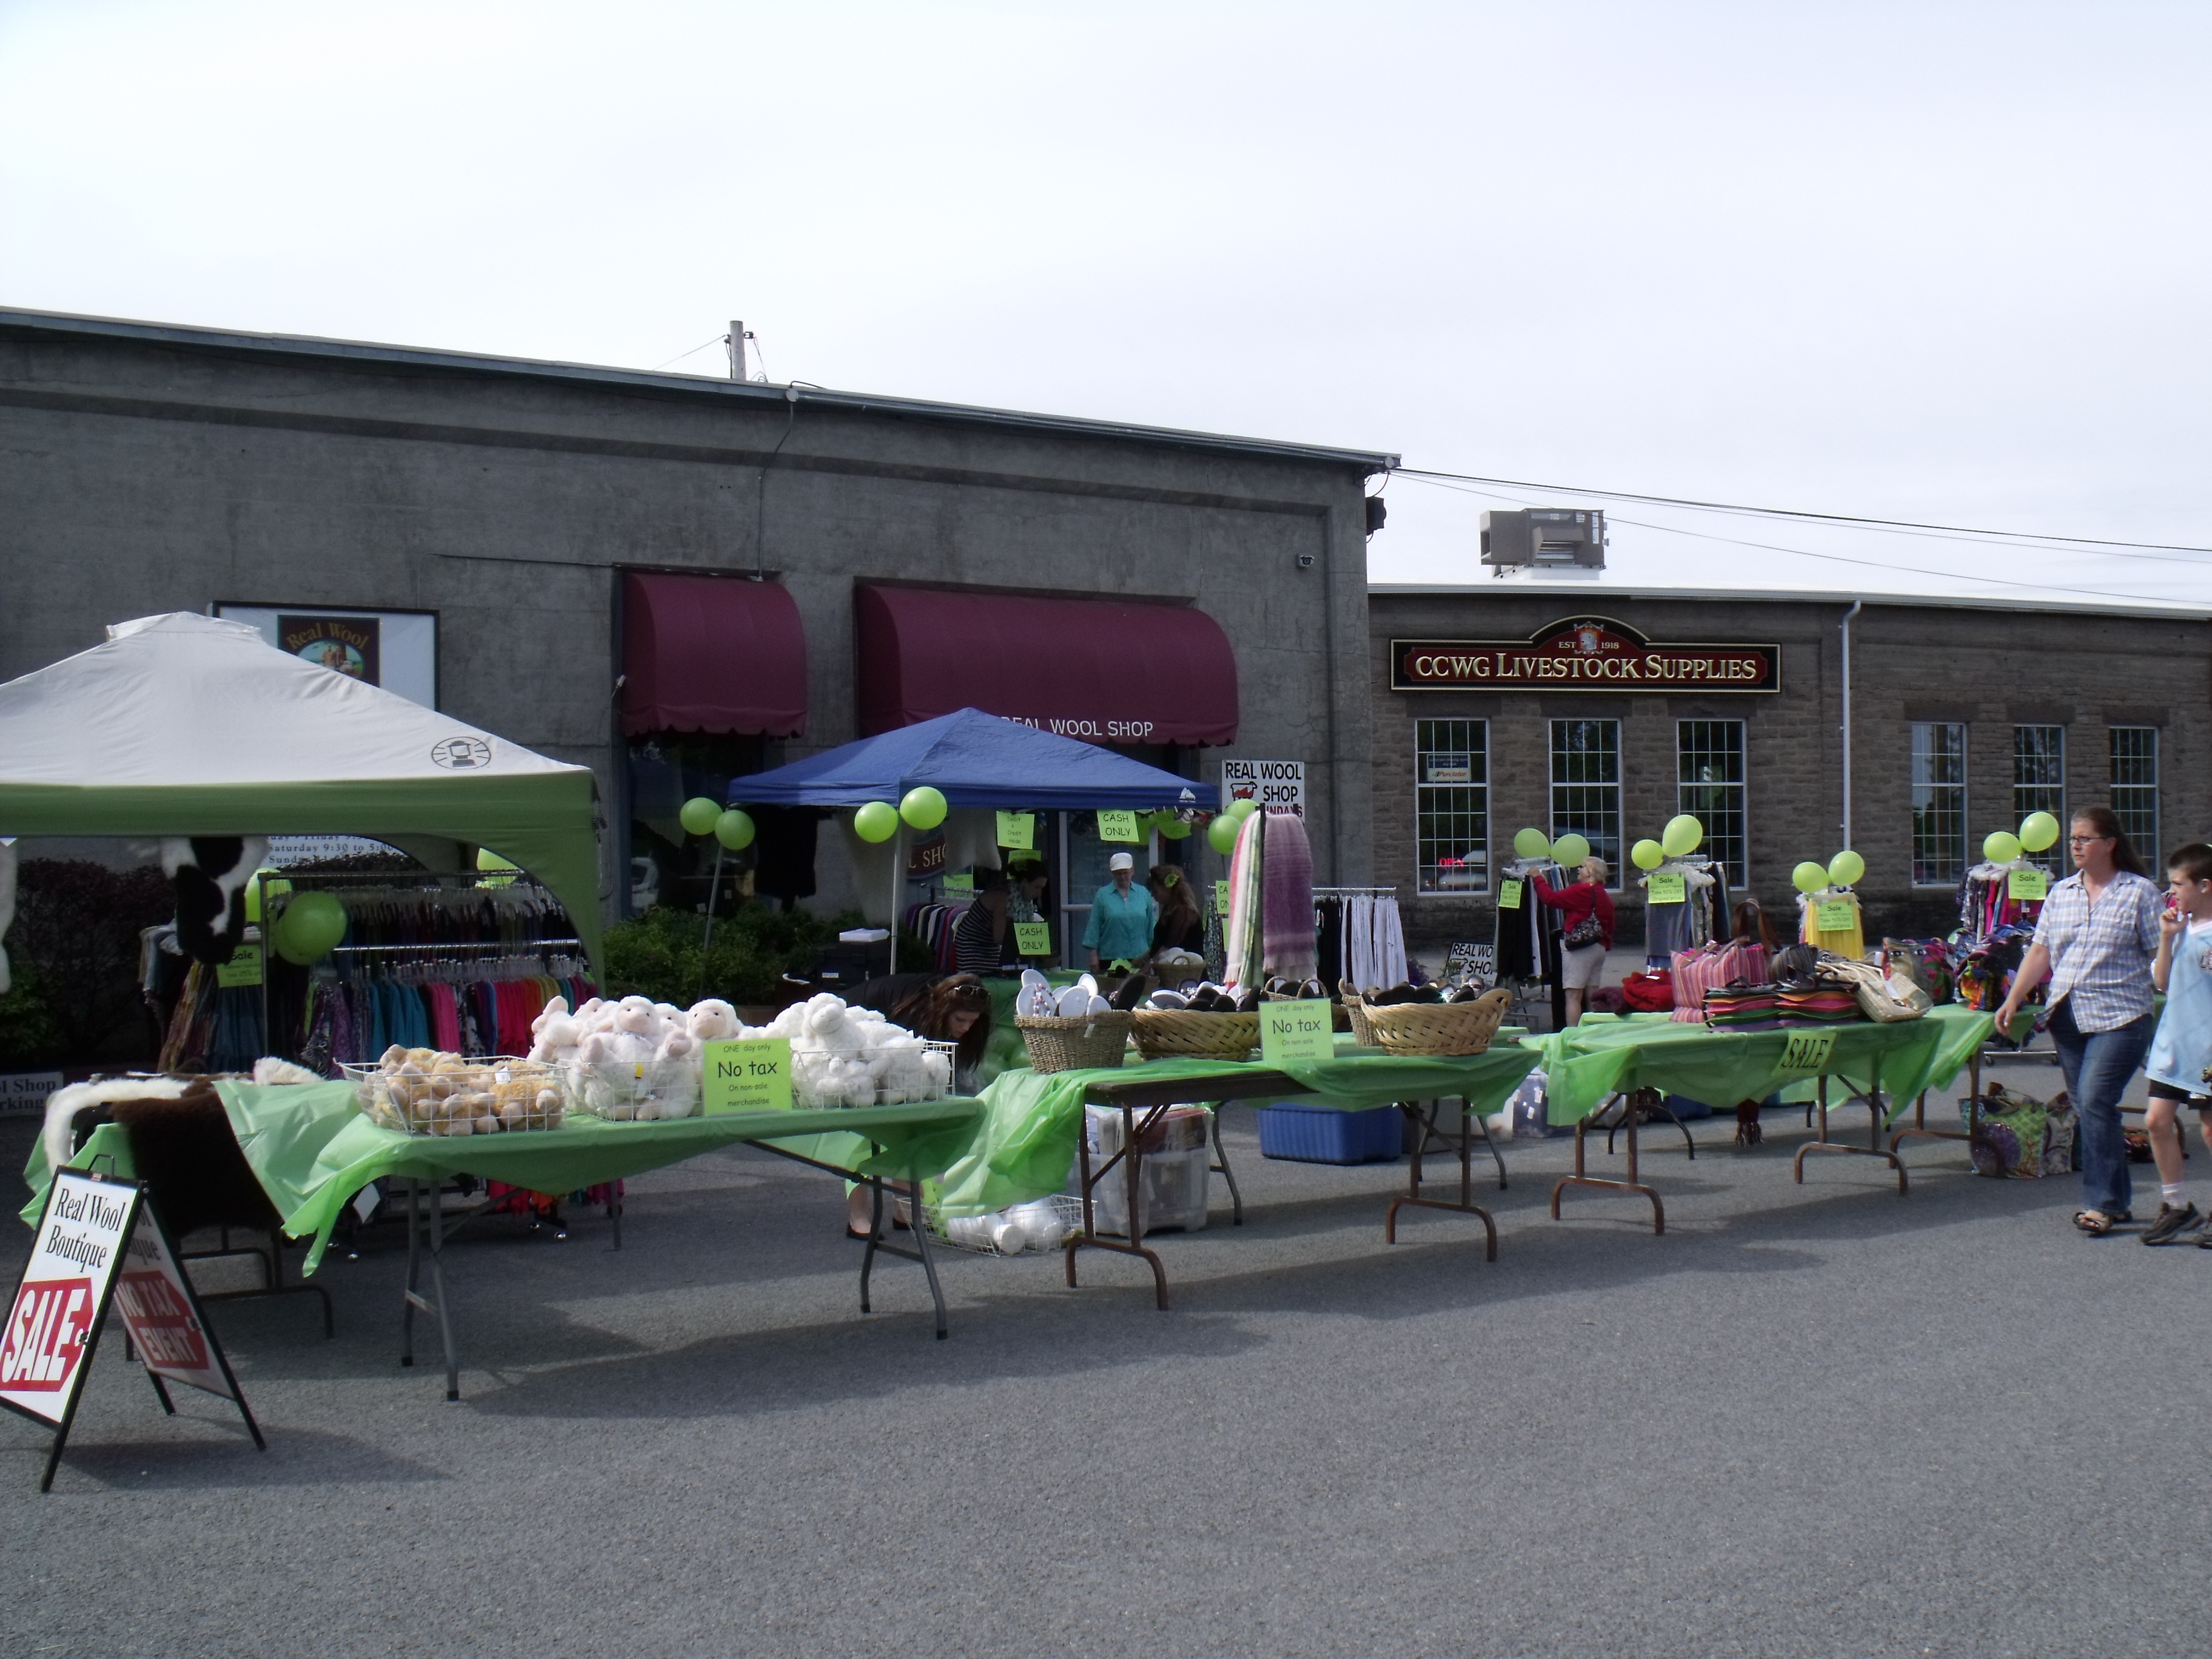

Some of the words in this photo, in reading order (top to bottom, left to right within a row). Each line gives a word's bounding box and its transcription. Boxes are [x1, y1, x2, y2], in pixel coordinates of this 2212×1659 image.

[286, 623, 323, 650] Real
[329, 622, 369, 649] Wool
[1415, 656, 1490, 678] CCWG
[1496, 652, 1641, 679] LIVESTOCK
[1645, 654, 1757, 679] SUPPLIES
[1001, 717, 1039, 729] AL
[1050, 719, 1102, 736] WOOL
[1108, 721, 1153, 736] SHOP
[1225, 762, 1257, 779] REAL
[1261, 763, 1302, 780] WOOL
[1263, 785, 1298, 802] SHOP
[1103, 814, 1129, 823] CASH
[1105, 827, 1131, 836] ONLY
[269, 843, 318, 853] Saturday
[1439, 857, 1464, 868] OPEN
[1452, 943, 1475, 957] REAL
[1478, 945, 1493, 957] WO
[1467, 960, 1492, 975] SHO
[1273, 1019, 1292, 1034] No
[1297, 1019, 1321, 1032] tax
[743, 1044, 756, 1053] day
[757, 1043, 771, 1052] only
[1780, 1037, 1829, 1069] SALE
[718, 1061, 742, 1078] No
[748, 1061, 777, 1076] tax
[14, 1079, 56, 1094] Shop
[740, 1082, 768, 1091] non-sale
[728, 1098, 770, 1107] merchandise
[55, 1188, 89, 1222] Real
[89, 1195, 127, 1232] Wool
[45, 1224, 107, 1273] Boutique
[115, 1281, 146, 1317] NO
[137, 1279, 181, 1317] TAX
[2, 1288, 87, 1384] SALE
[138, 1327, 198, 1362] EVENT
